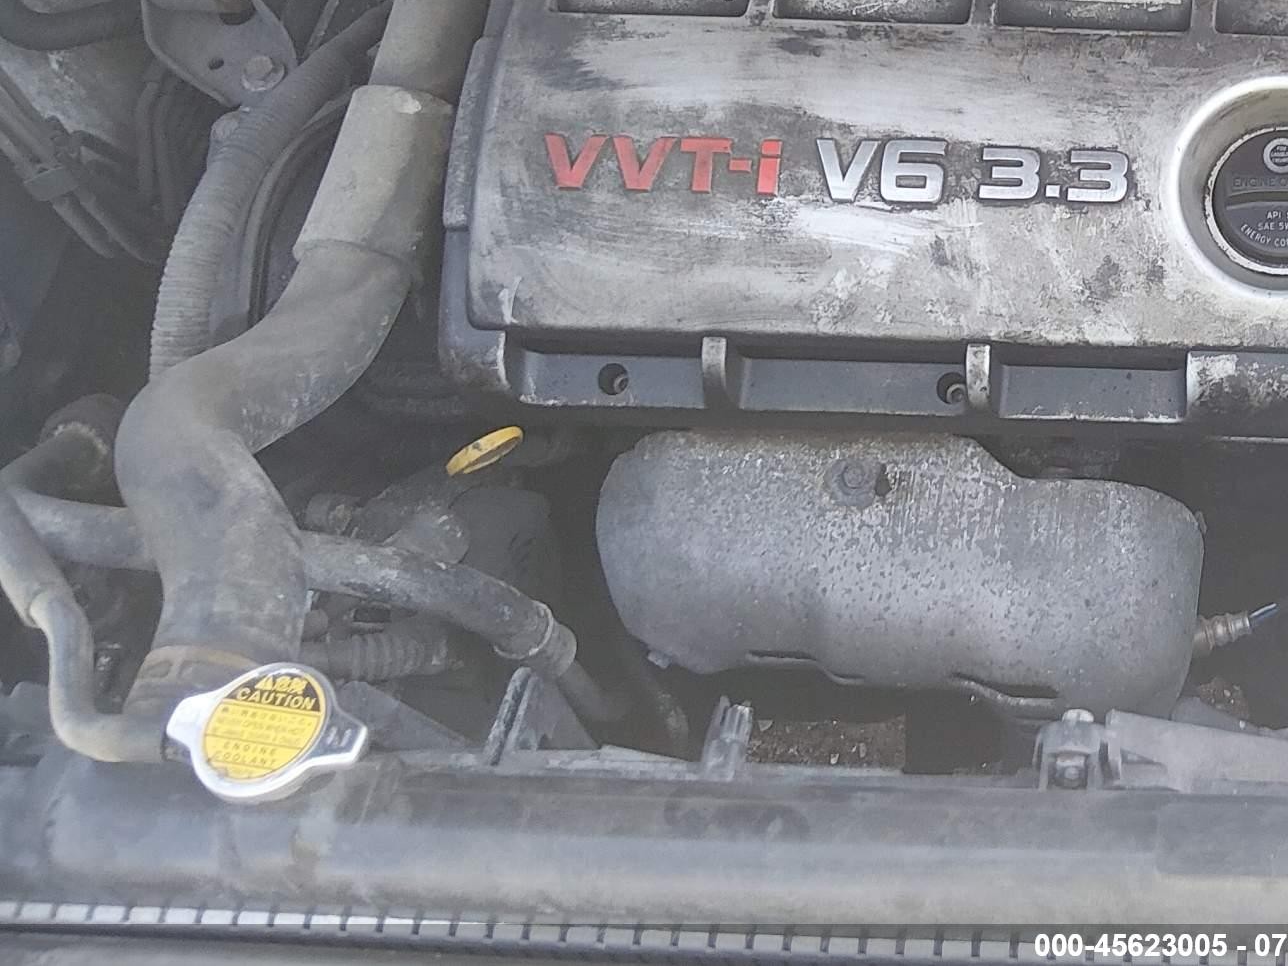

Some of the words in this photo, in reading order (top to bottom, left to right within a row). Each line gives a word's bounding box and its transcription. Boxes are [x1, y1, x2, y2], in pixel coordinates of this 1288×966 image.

[544, 133, 783, 195] VVT-i
[816, 137, 947, 204] V6
[977, 144, 1131, 204] 3.3
[1266, 211, 1282, 220] API
[1240, 224, 1271, 244] ENERGY
[1257, 222, 1275, 231] SAE
[236, 686, 317, 711] CAUTION
[223, 740, 278, 757] ENGINE
[214, 749, 278, 767] COOLANT
